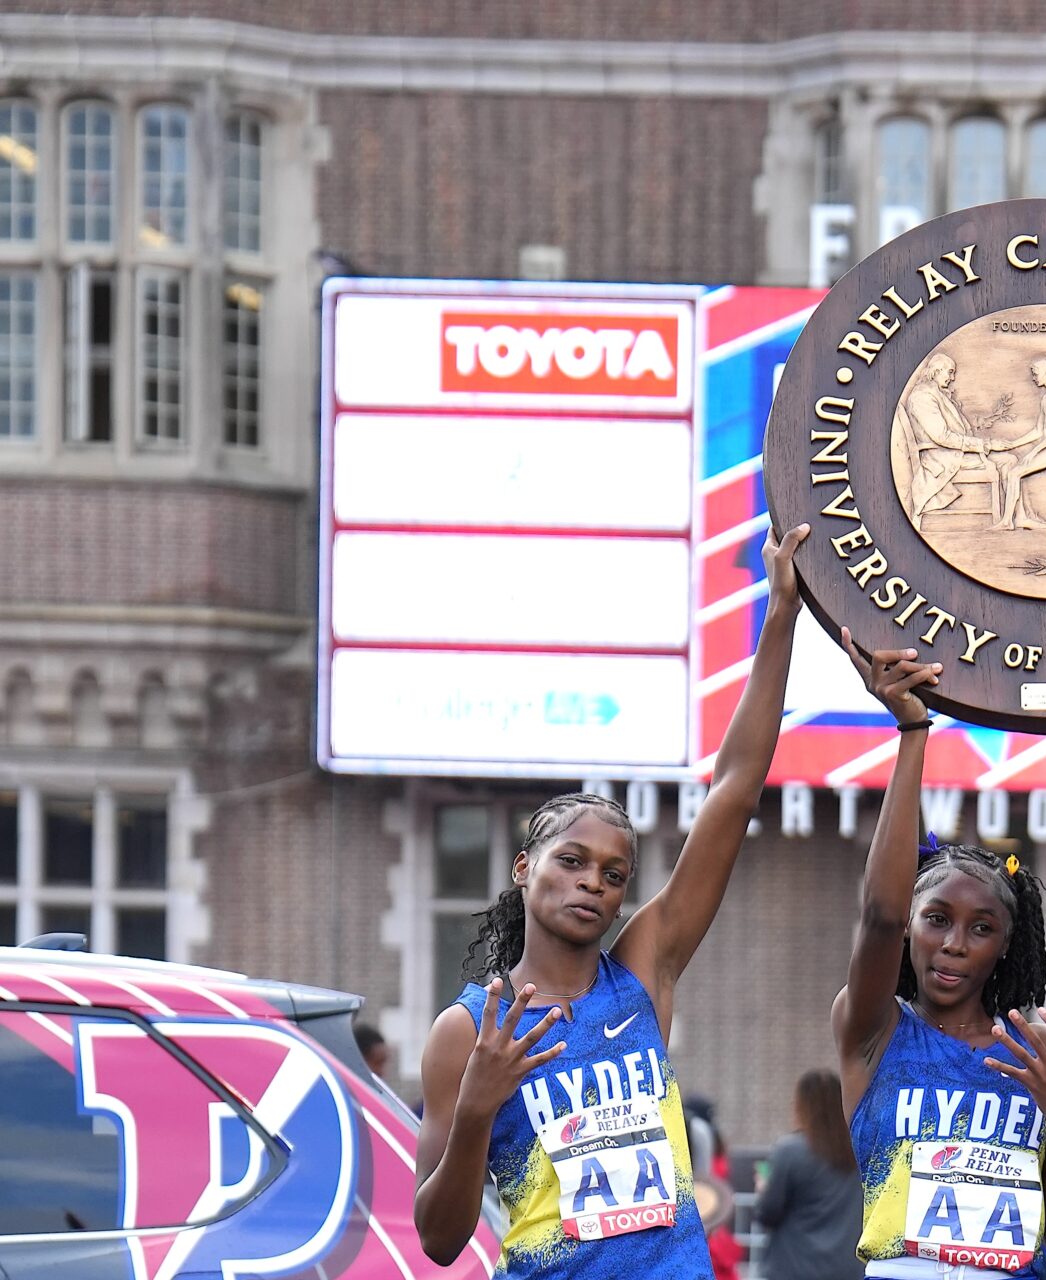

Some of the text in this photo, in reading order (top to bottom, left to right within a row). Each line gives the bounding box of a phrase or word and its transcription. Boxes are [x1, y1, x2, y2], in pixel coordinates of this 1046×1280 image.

[838, 243, 984, 368] RELAY
[445, 326, 676, 380] TOYOTA
[809, 395, 998, 665] UNIVERSITY
[1003, 642, 1043, 670] OF
[594, 1103, 633, 1120] PENN
[597, 1113, 648, 1131] RELAYS
[969, 1147, 1012, 1164] PENN
[964, 1160, 1023, 1177] RELAYS
[604, 1206, 675, 1231] TOYOTA
[945, 1249, 1021, 1269] TOYOTA
